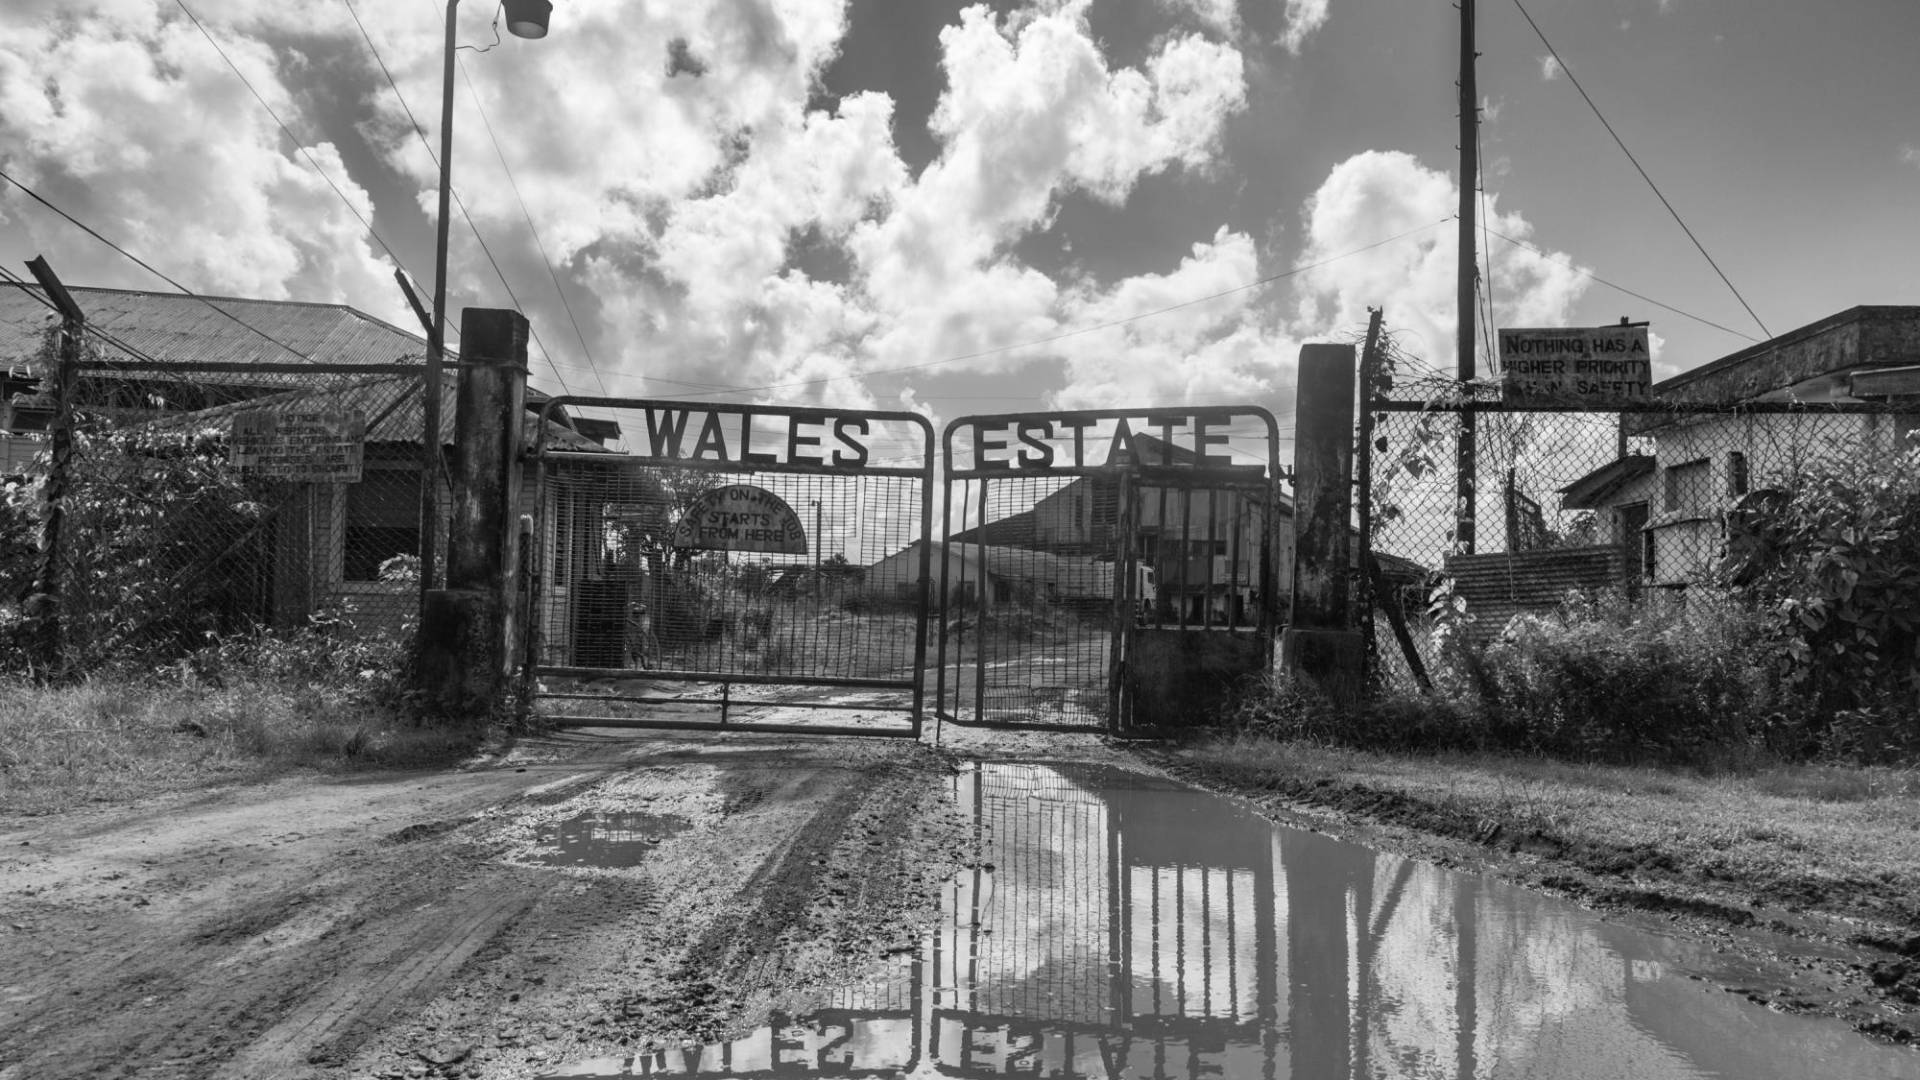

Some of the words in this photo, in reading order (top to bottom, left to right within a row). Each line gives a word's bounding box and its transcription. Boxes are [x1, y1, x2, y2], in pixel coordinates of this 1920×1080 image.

[1505, 335, 1583, 354] NOTHING
[1593, 338, 1626, 352] HAS
[1631, 338, 1645, 352] A
[1502, 360, 1565, 374] HIGHER
[1575, 360, 1649, 374] PRIORITY
[644, 407, 870, 467] WALES
[973, 415, 1232, 470] ESTATE
[730, 488, 750, 501] ON
[708, 511, 770, 527] STARTS
[699, 526, 738, 540] FROM
